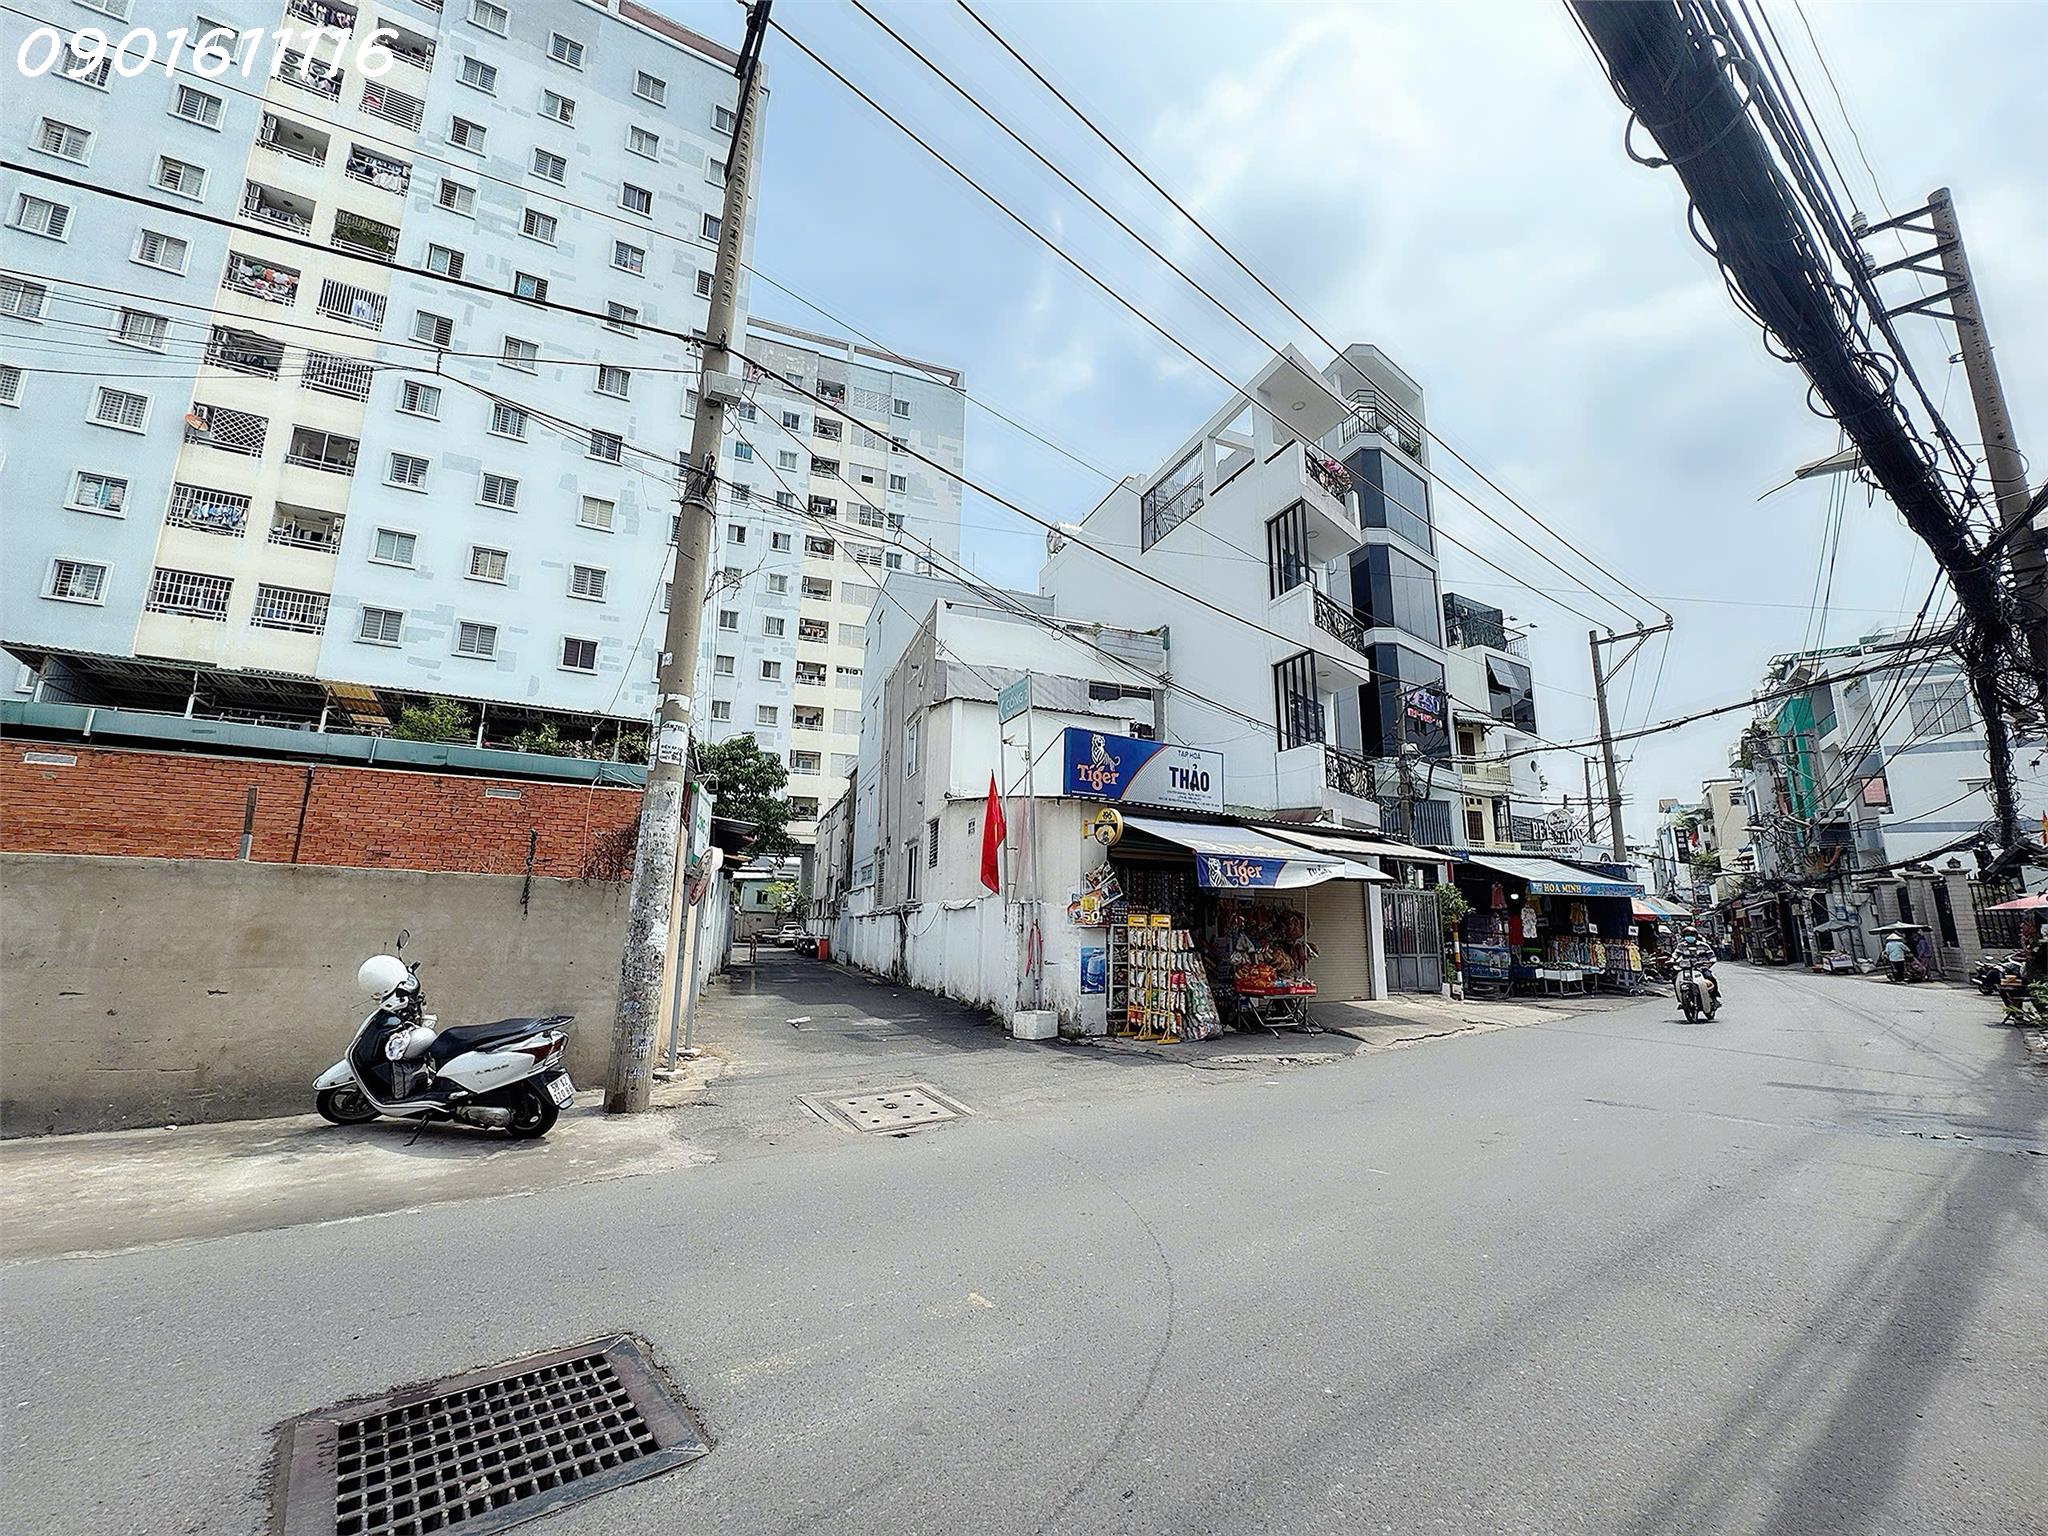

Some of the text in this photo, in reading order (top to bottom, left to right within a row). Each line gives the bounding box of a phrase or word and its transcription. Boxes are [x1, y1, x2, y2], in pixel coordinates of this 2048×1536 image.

[1076, 763, 1120, 791] Tiger
[1169, 763, 1210, 793] THẢO
[1222, 860, 1263, 886] Tiger
